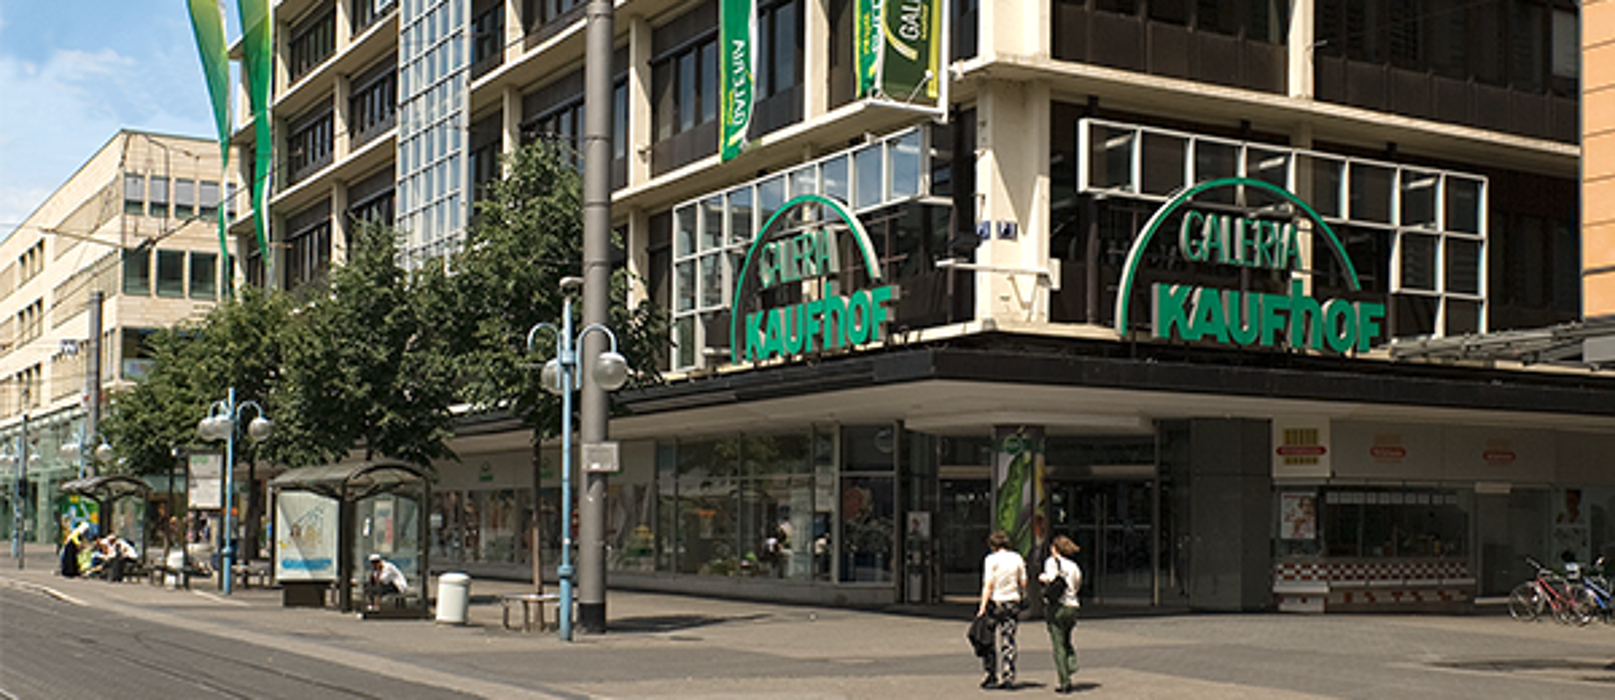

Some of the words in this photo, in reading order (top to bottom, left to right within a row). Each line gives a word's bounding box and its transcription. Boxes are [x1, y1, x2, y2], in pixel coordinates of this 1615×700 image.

[899, 0, 921, 40] GAL
[759, 229, 840, 289] GALERIA
[1180, 210, 1303, 270] GALERIA
